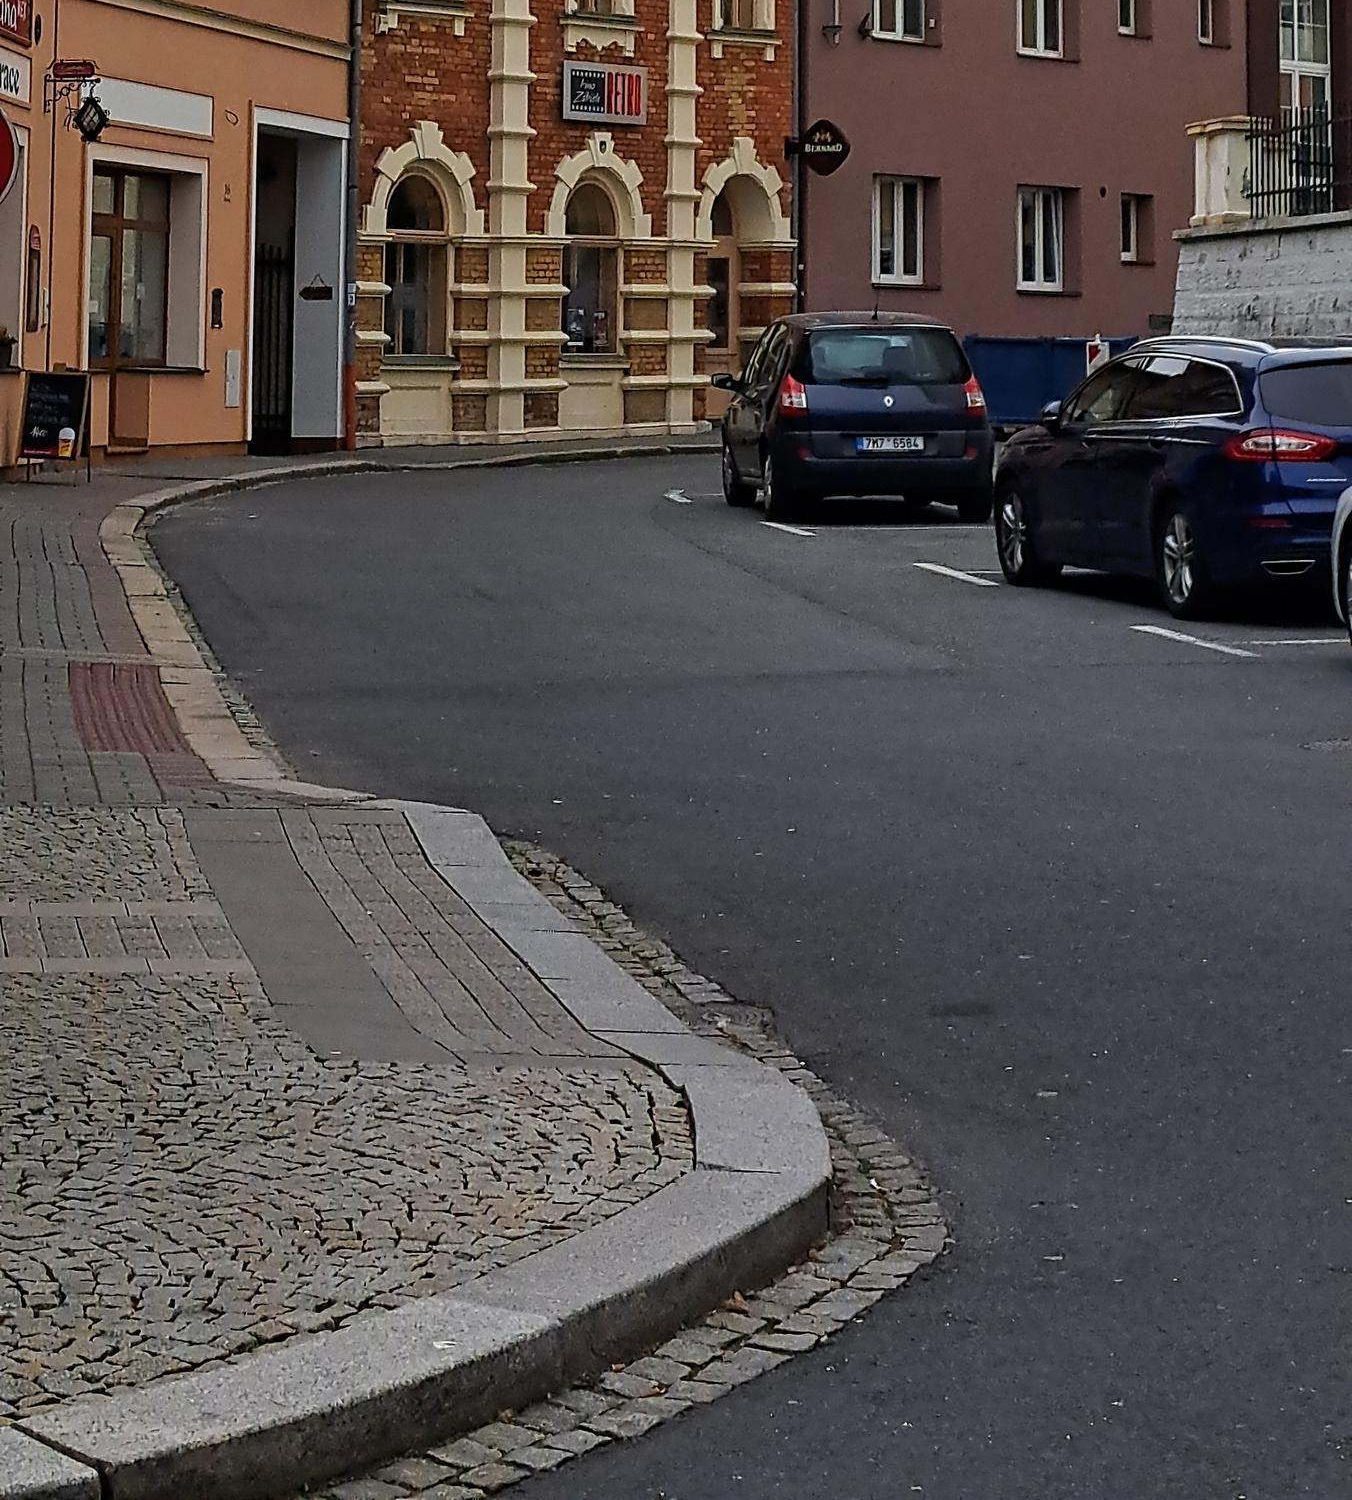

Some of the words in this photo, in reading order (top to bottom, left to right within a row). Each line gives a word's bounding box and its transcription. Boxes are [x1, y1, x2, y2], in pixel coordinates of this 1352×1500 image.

[606, 71, 642, 117] RETRO
[804, 143, 843, 153] BERNARD
[865, 437, 885, 449] 7M7
